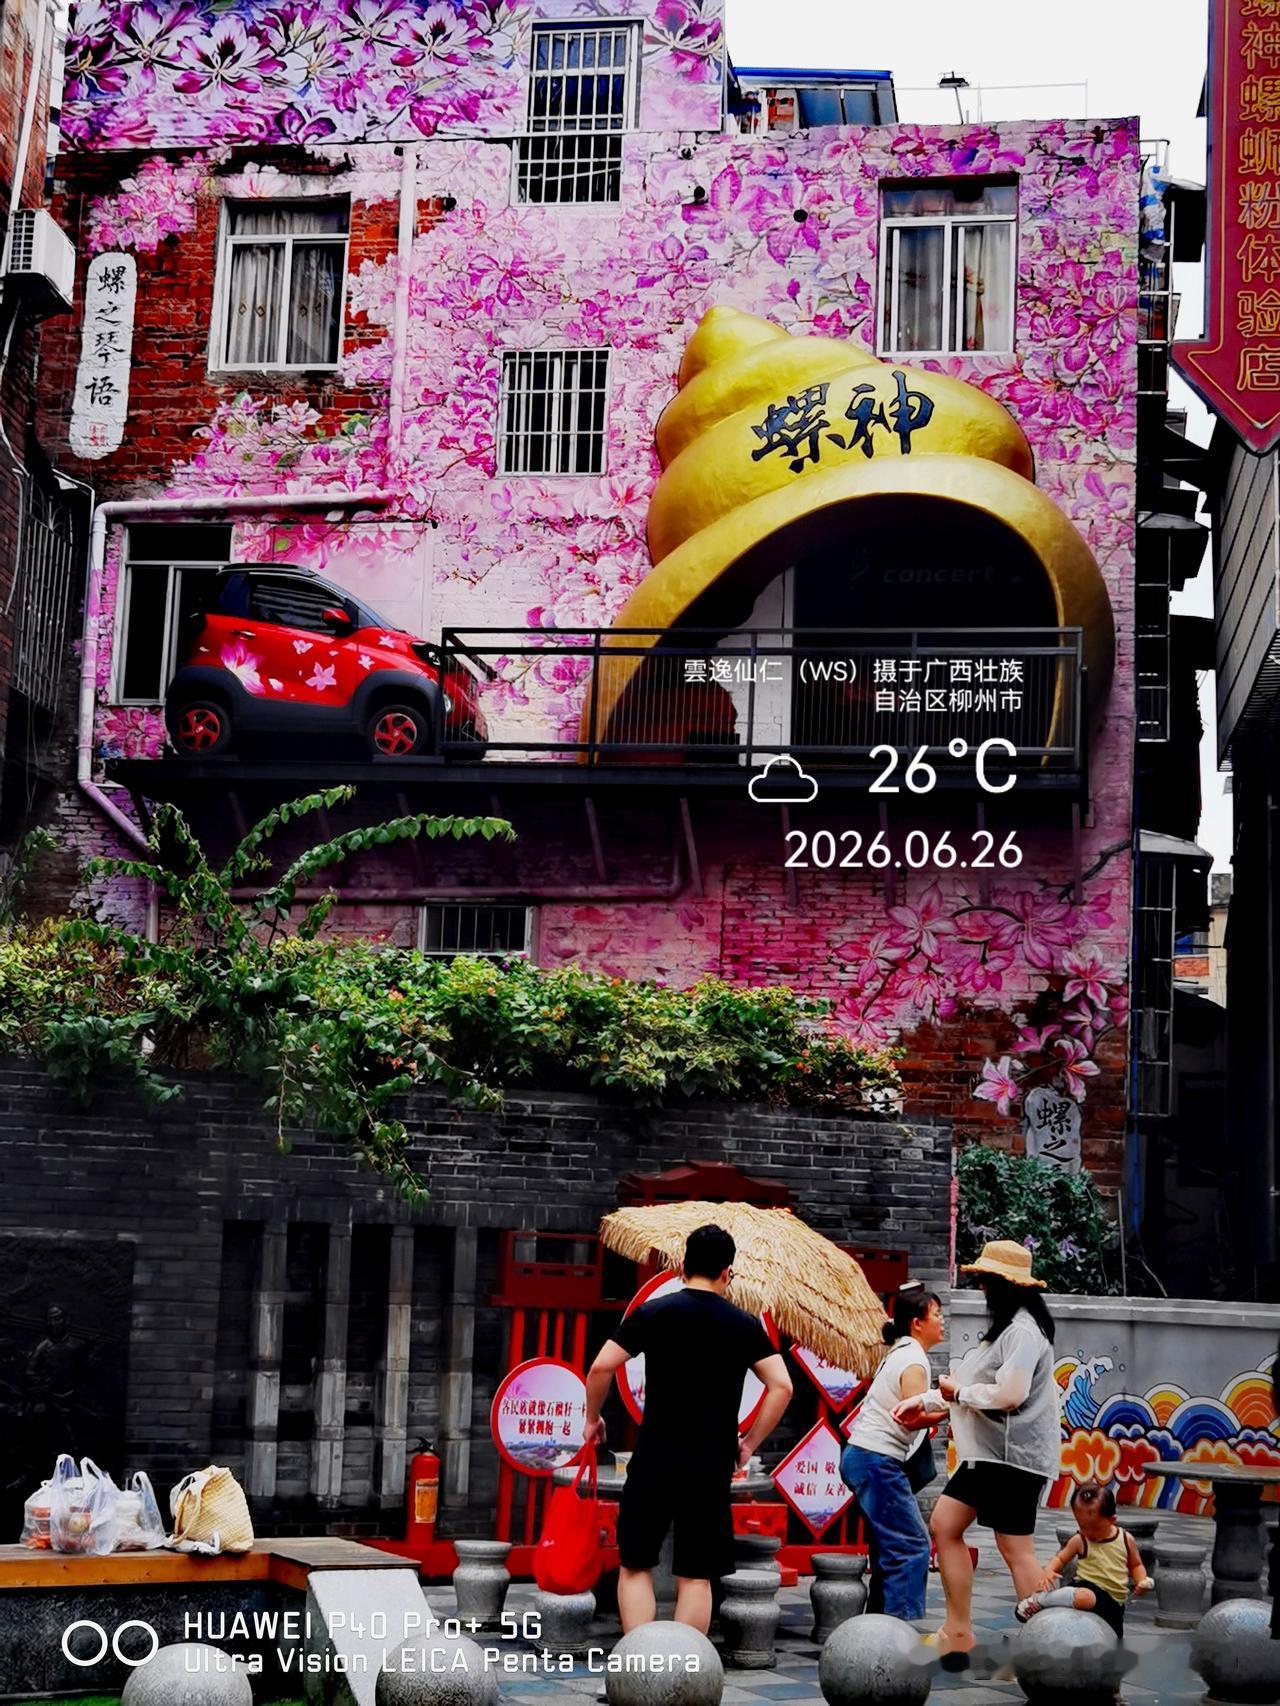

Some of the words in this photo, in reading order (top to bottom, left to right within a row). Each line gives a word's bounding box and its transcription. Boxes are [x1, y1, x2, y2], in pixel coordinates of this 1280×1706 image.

[1237, 0, 1280, 391] 神螺蛳粉体验店
[750, 370, 935, 474] 螺神
